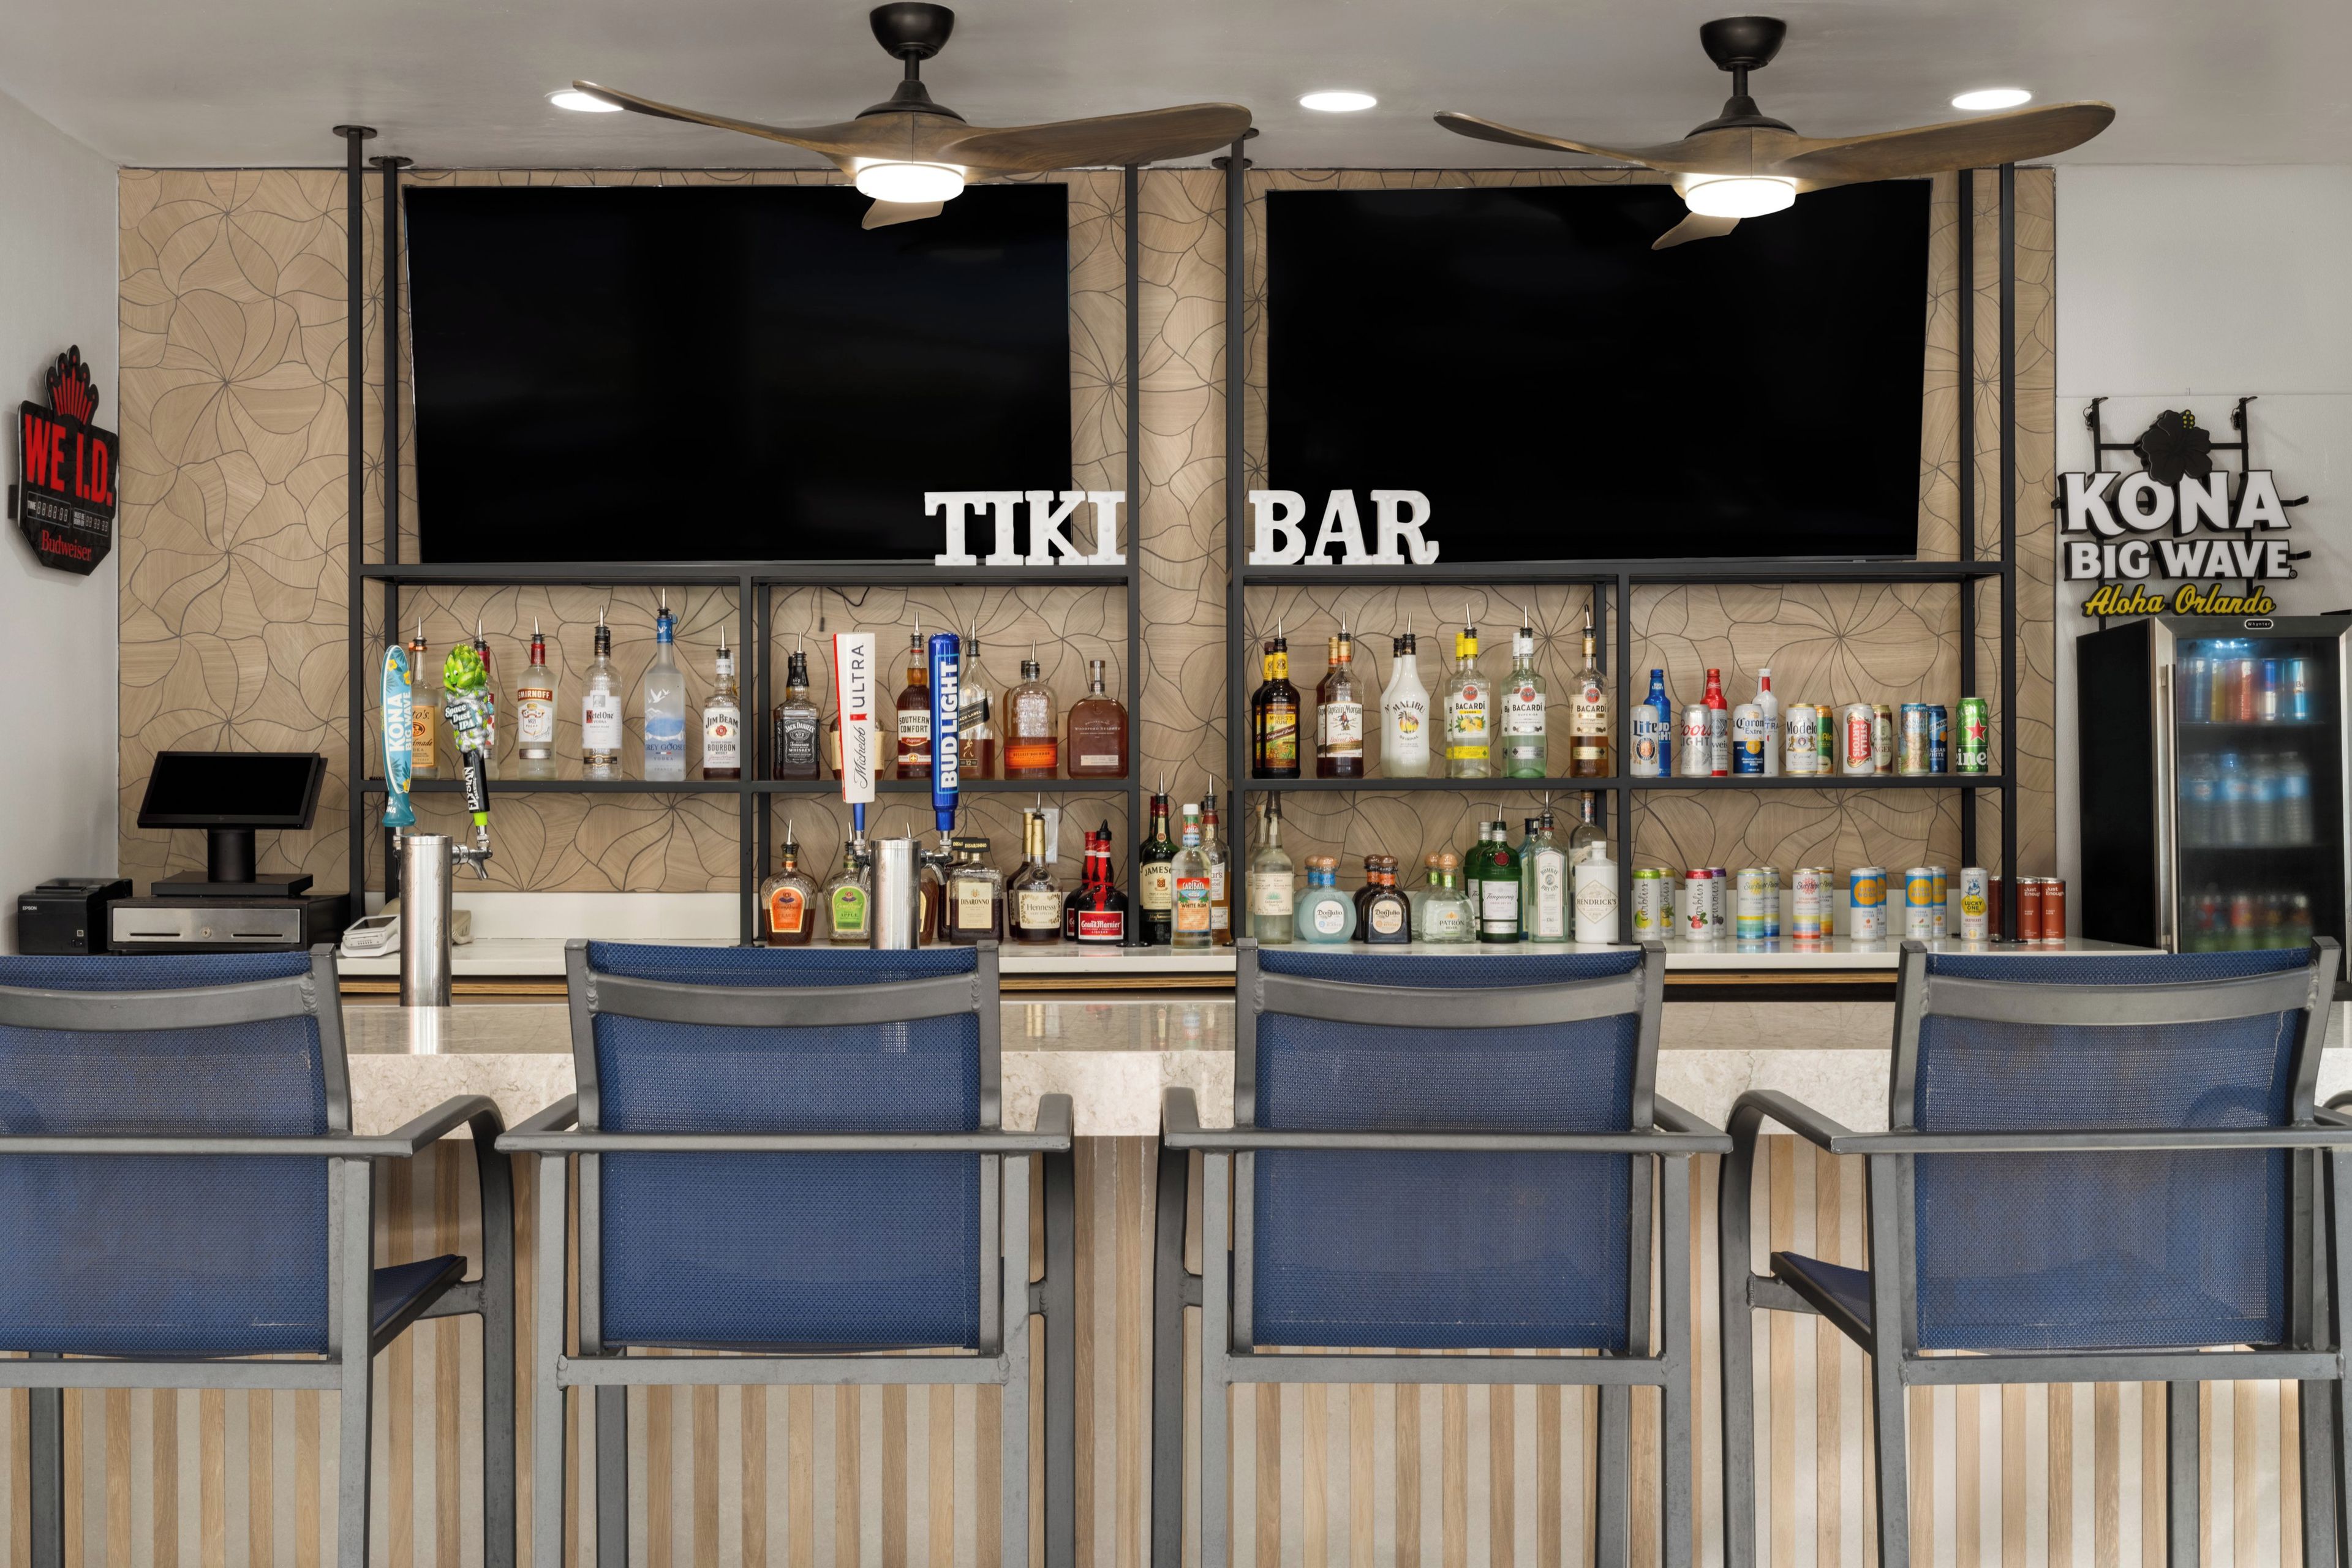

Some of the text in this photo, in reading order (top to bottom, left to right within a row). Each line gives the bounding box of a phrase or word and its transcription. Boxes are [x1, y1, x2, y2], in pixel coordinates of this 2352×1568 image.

[24, 413, 112, 507] WE I.D.
[28, 500, 36, 510] TIME
[2059, 470, 2291, 537] KONA
[924, 489, 1439, 566] TIKI BAR
[42, 529, 91, 561] Budweiser
[2065, 539, 2291, 580] BIG WAVE
[2084, 584, 2275, 616] Aloha Orlando
[851, 644, 865, 708] ULTRA
[403, 692, 412, 725] WAVE
[445, 704, 466, 717] Space
[1327, 705, 1344, 715] Captain
[1345, 705, 1362, 715] Morgan
[1393, 700, 1426, 714] MALIBU
[1455, 700, 1485, 710] BACARDÍ
[1512, 703, 1542, 711] BACARDÍ
[1577, 704, 1607, 712] BACARDÍ
[387, 693, 405, 752] KONA
[453, 711, 471, 723] Dust
[587, 710, 601, 723] Ketel
[706, 714, 738, 729] JIM BEAM
[899, 716, 930, 725] SOUTHERN
[459, 720, 475, 731] IPA
[785, 722, 815, 733] JACK DANIEL'S
[941, 661, 958, 788] BUD LIGHT
[1633, 720, 1657, 737] Lite
[1736, 717, 1764, 730] Coron
[1936, 720, 1947, 729] MOO
[1267, 730, 1284, 740] Original
[1681, 737, 1709, 746] IGHT
[853, 725, 868, 789] Michelob
[464, 767, 479, 810] ELYSIAN
[1145, 866, 1172, 876] JAMES
[1540, 867, 1558, 876] BOMBAY
[1487, 892, 1515, 901] Tanqueray
[1027, 903, 1057, 912] Hennessy
